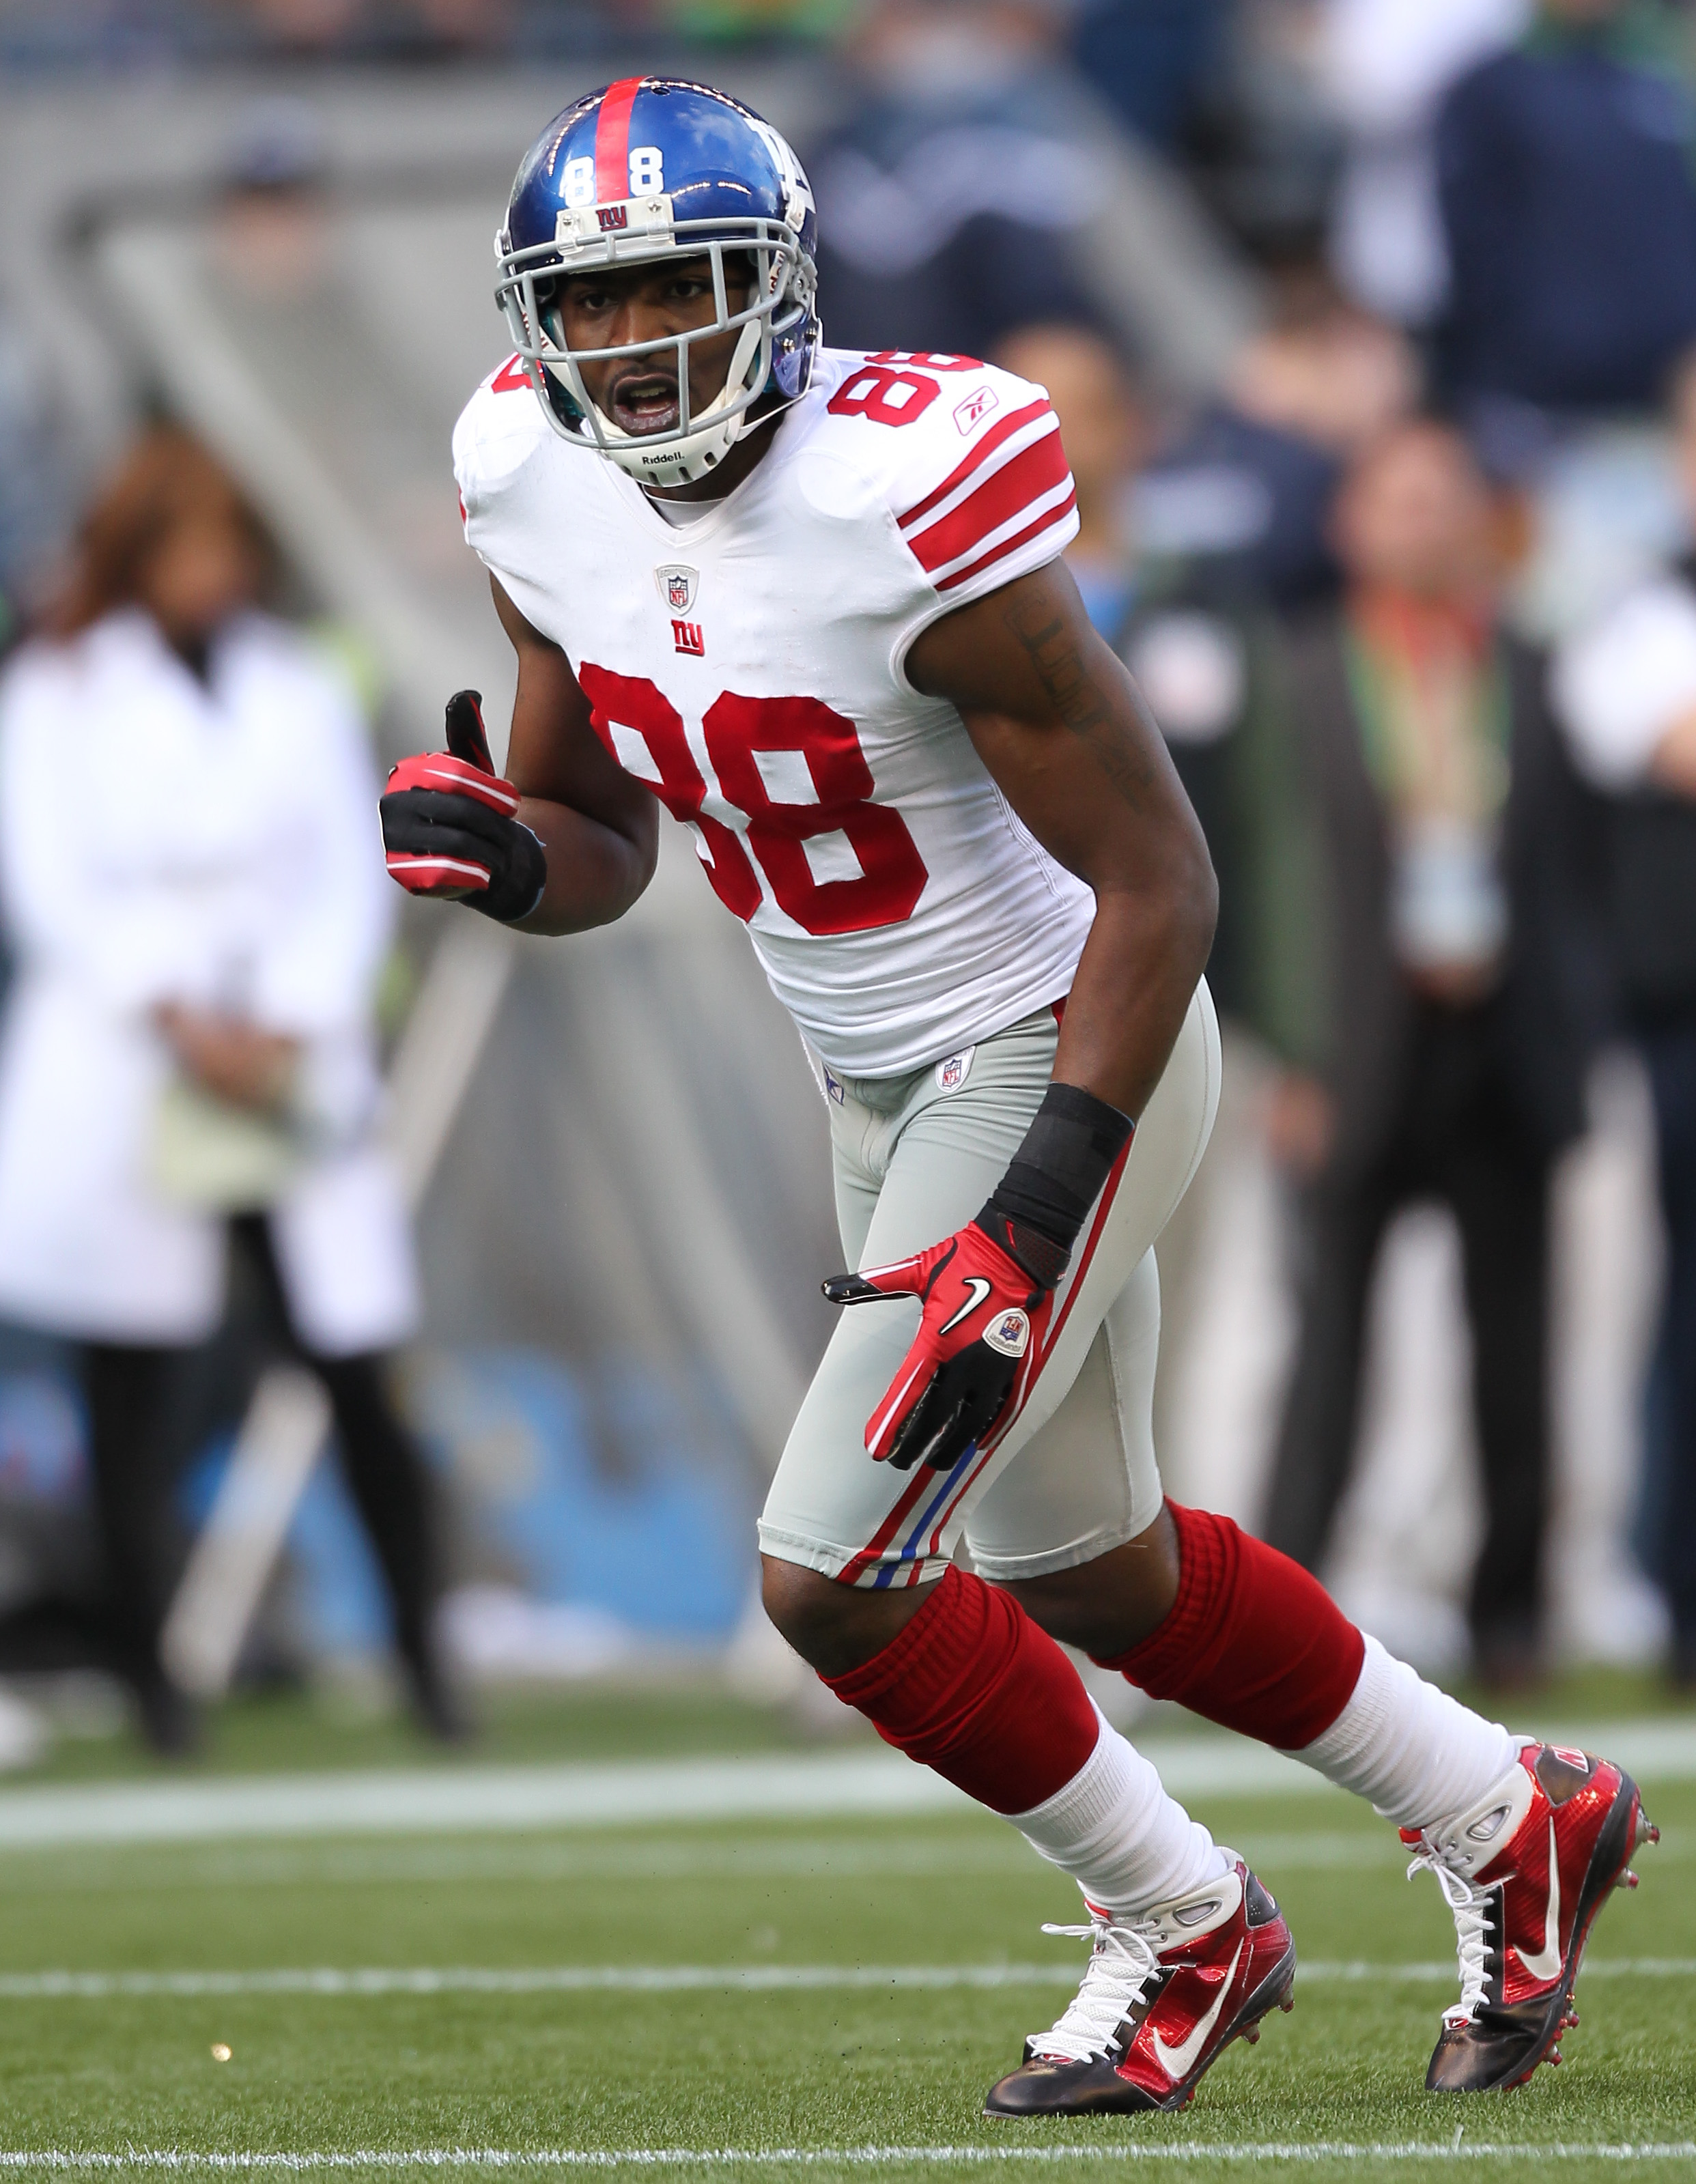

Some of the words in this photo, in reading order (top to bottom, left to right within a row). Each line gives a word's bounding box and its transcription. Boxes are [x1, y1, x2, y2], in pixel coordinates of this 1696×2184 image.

[642, 451, 681, 465] Riddell
[670, 589, 687, 605] NFL
[579, 661, 929, 936] 88
[943, 1069, 959, 1085] NFL
